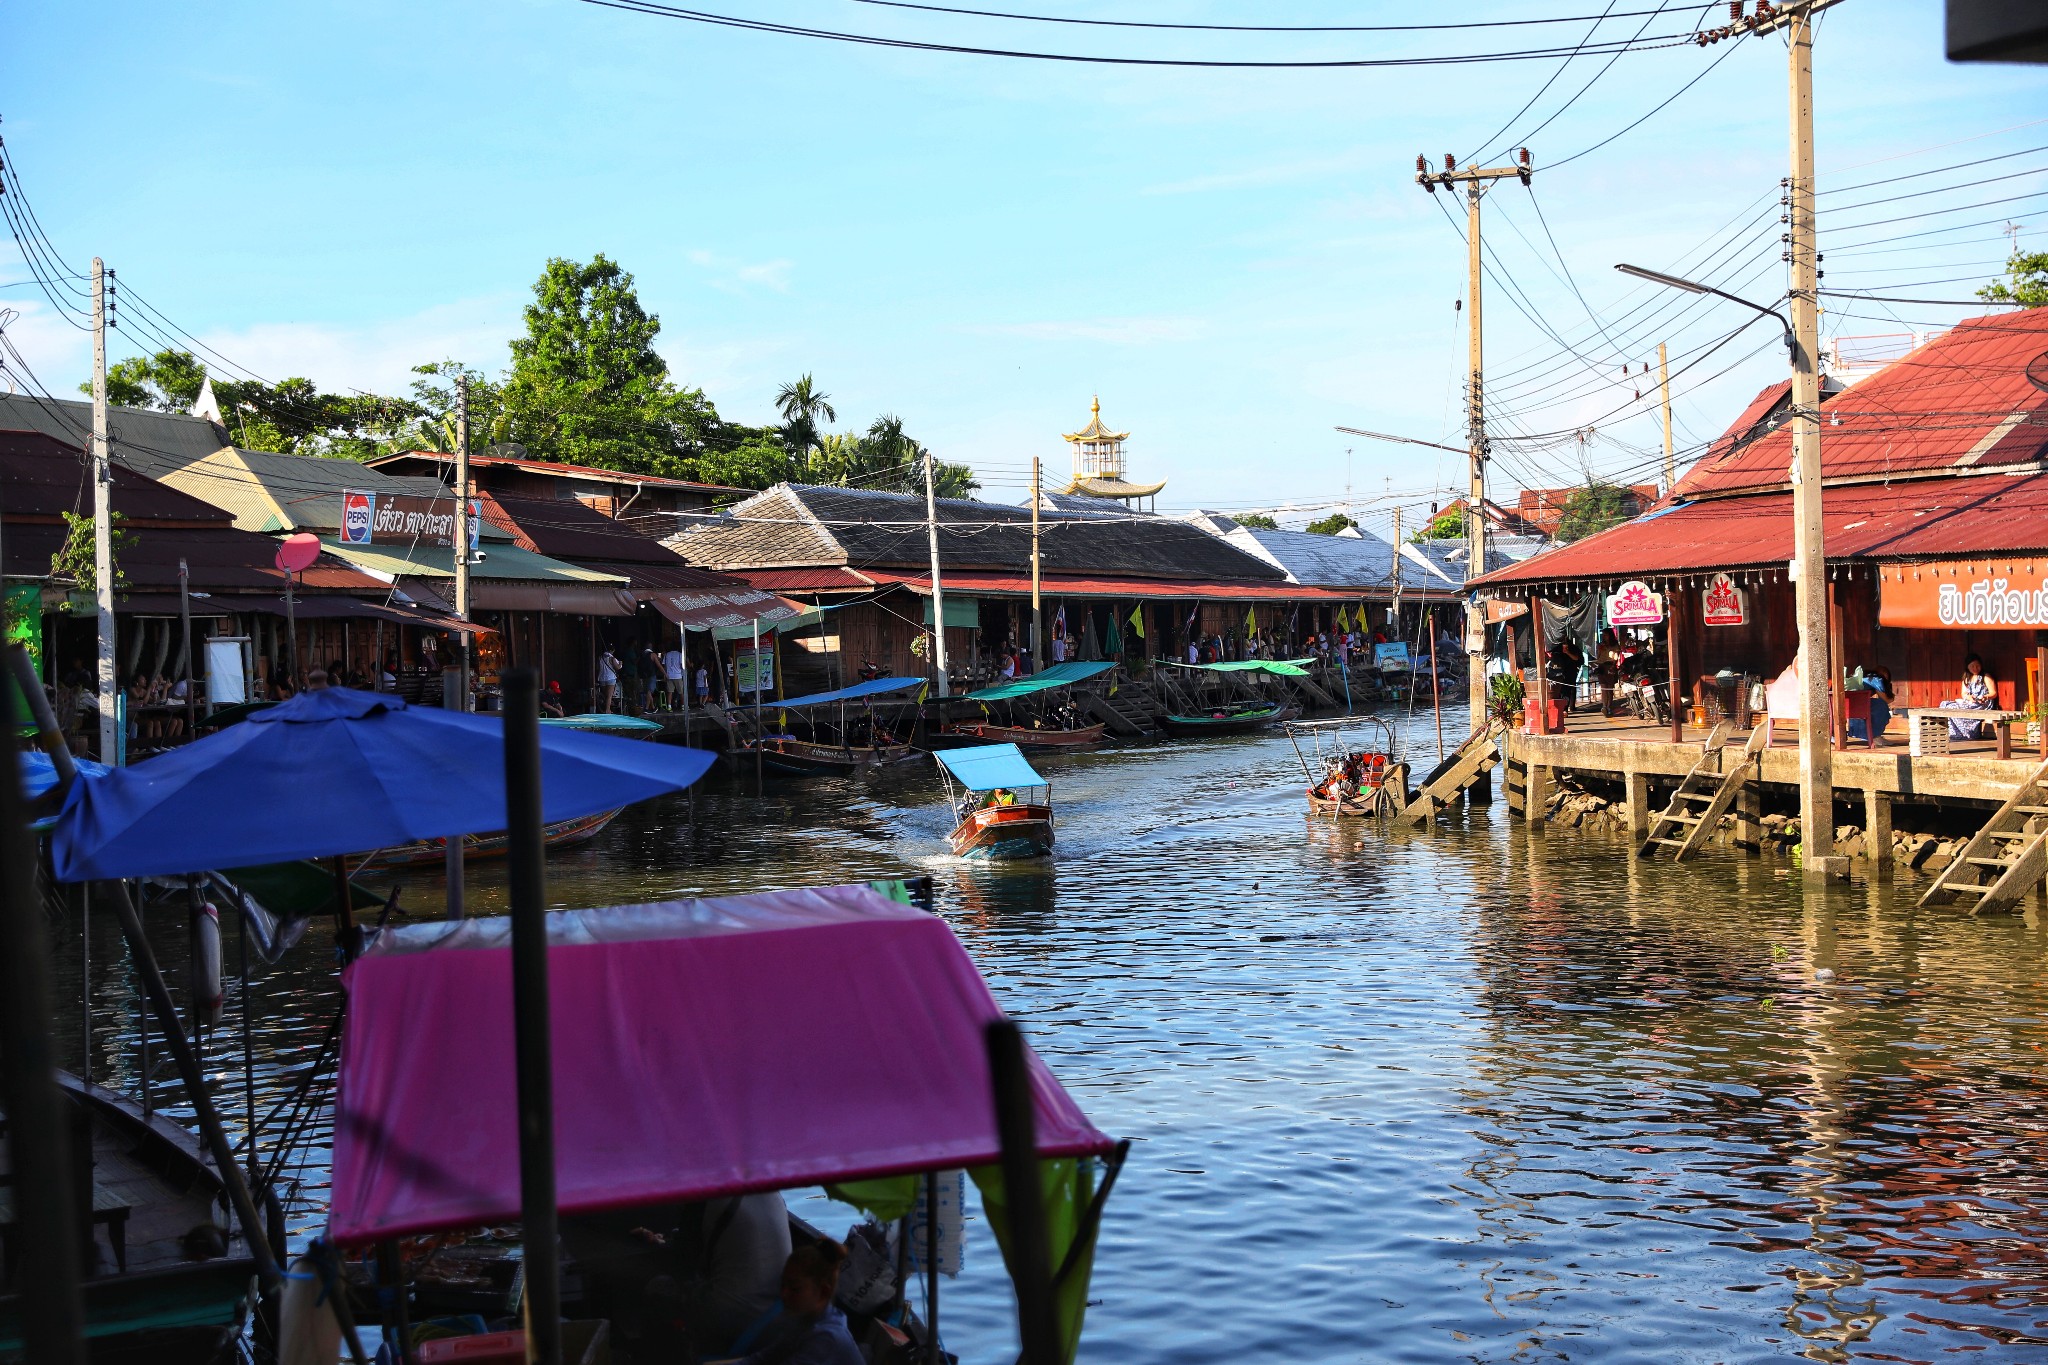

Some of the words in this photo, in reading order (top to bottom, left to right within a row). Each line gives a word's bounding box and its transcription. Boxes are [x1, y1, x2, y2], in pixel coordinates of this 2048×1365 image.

[347, 511, 369, 524] PEPSI
[373, 497, 405, 532] เตี๋ยว
[1613, 598, 1659, 616] SRIMALA
[1706, 594, 1741, 615] SRIMALA
